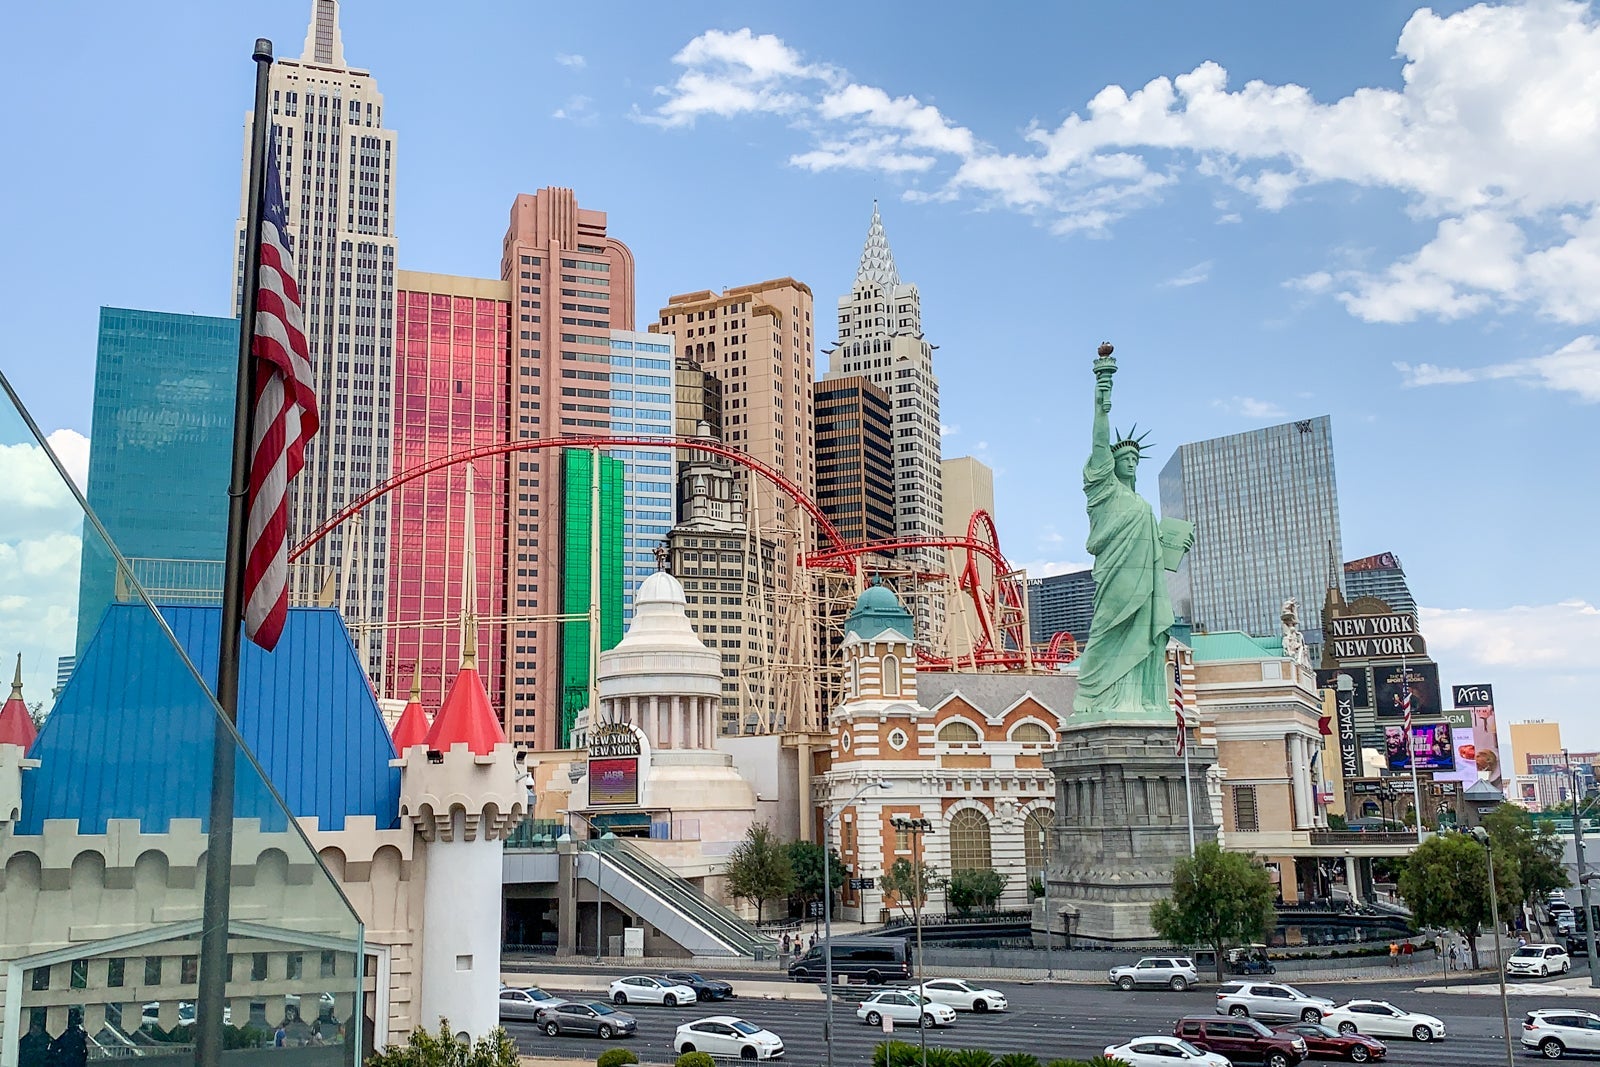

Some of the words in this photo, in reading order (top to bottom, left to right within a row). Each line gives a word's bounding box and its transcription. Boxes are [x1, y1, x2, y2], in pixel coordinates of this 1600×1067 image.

[1332, 619, 1366, 636] NEW
[1370, 616, 1413, 633] YORK
[1335, 640, 1368, 656] NEW
[1372, 636, 1415, 655] YORK
[1338, 699, 1353, 740] SHACK
[1445, 714, 1465, 723] GM
[589, 735, 609, 745] NEW
[611, 733, 638, 744] YORK
[589, 745, 609, 756] NEW
[611, 744, 638, 755] YORK
[1342, 743, 1357, 777] HAKE
